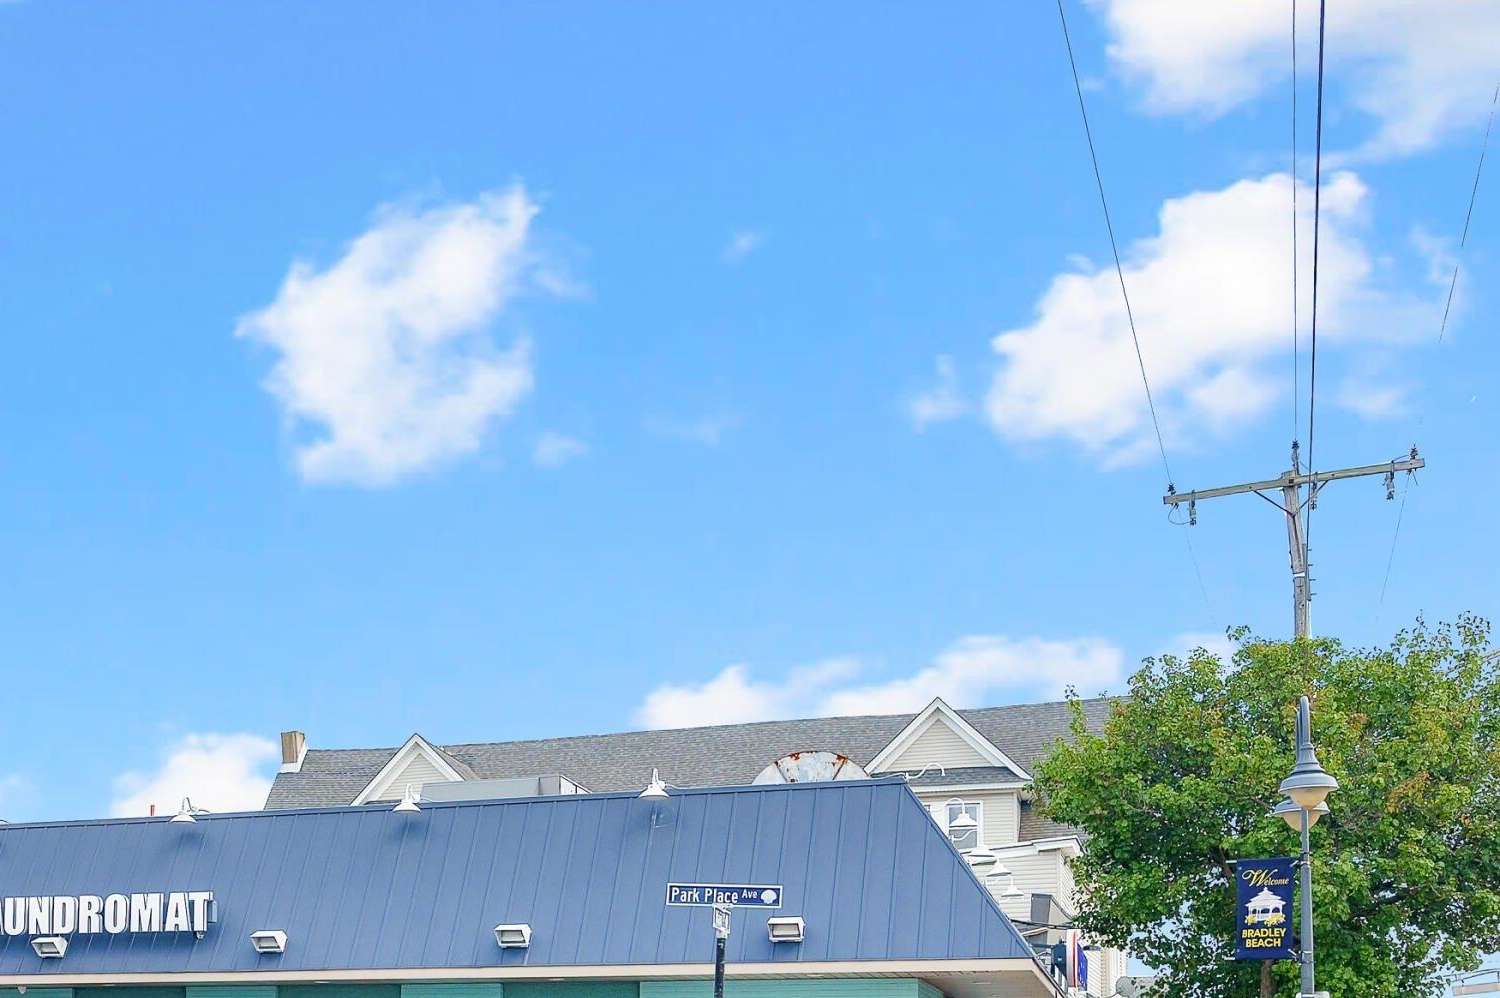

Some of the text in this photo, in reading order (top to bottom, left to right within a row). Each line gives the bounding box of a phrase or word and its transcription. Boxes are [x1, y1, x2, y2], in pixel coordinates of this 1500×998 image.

[1241, 868, 1290, 887] Welcome
[671, 887, 758, 903] Park Place Ave
[1242, 928, 1287, 938] BRADLEY
[1245, 938, 1282, 948] BEACH
